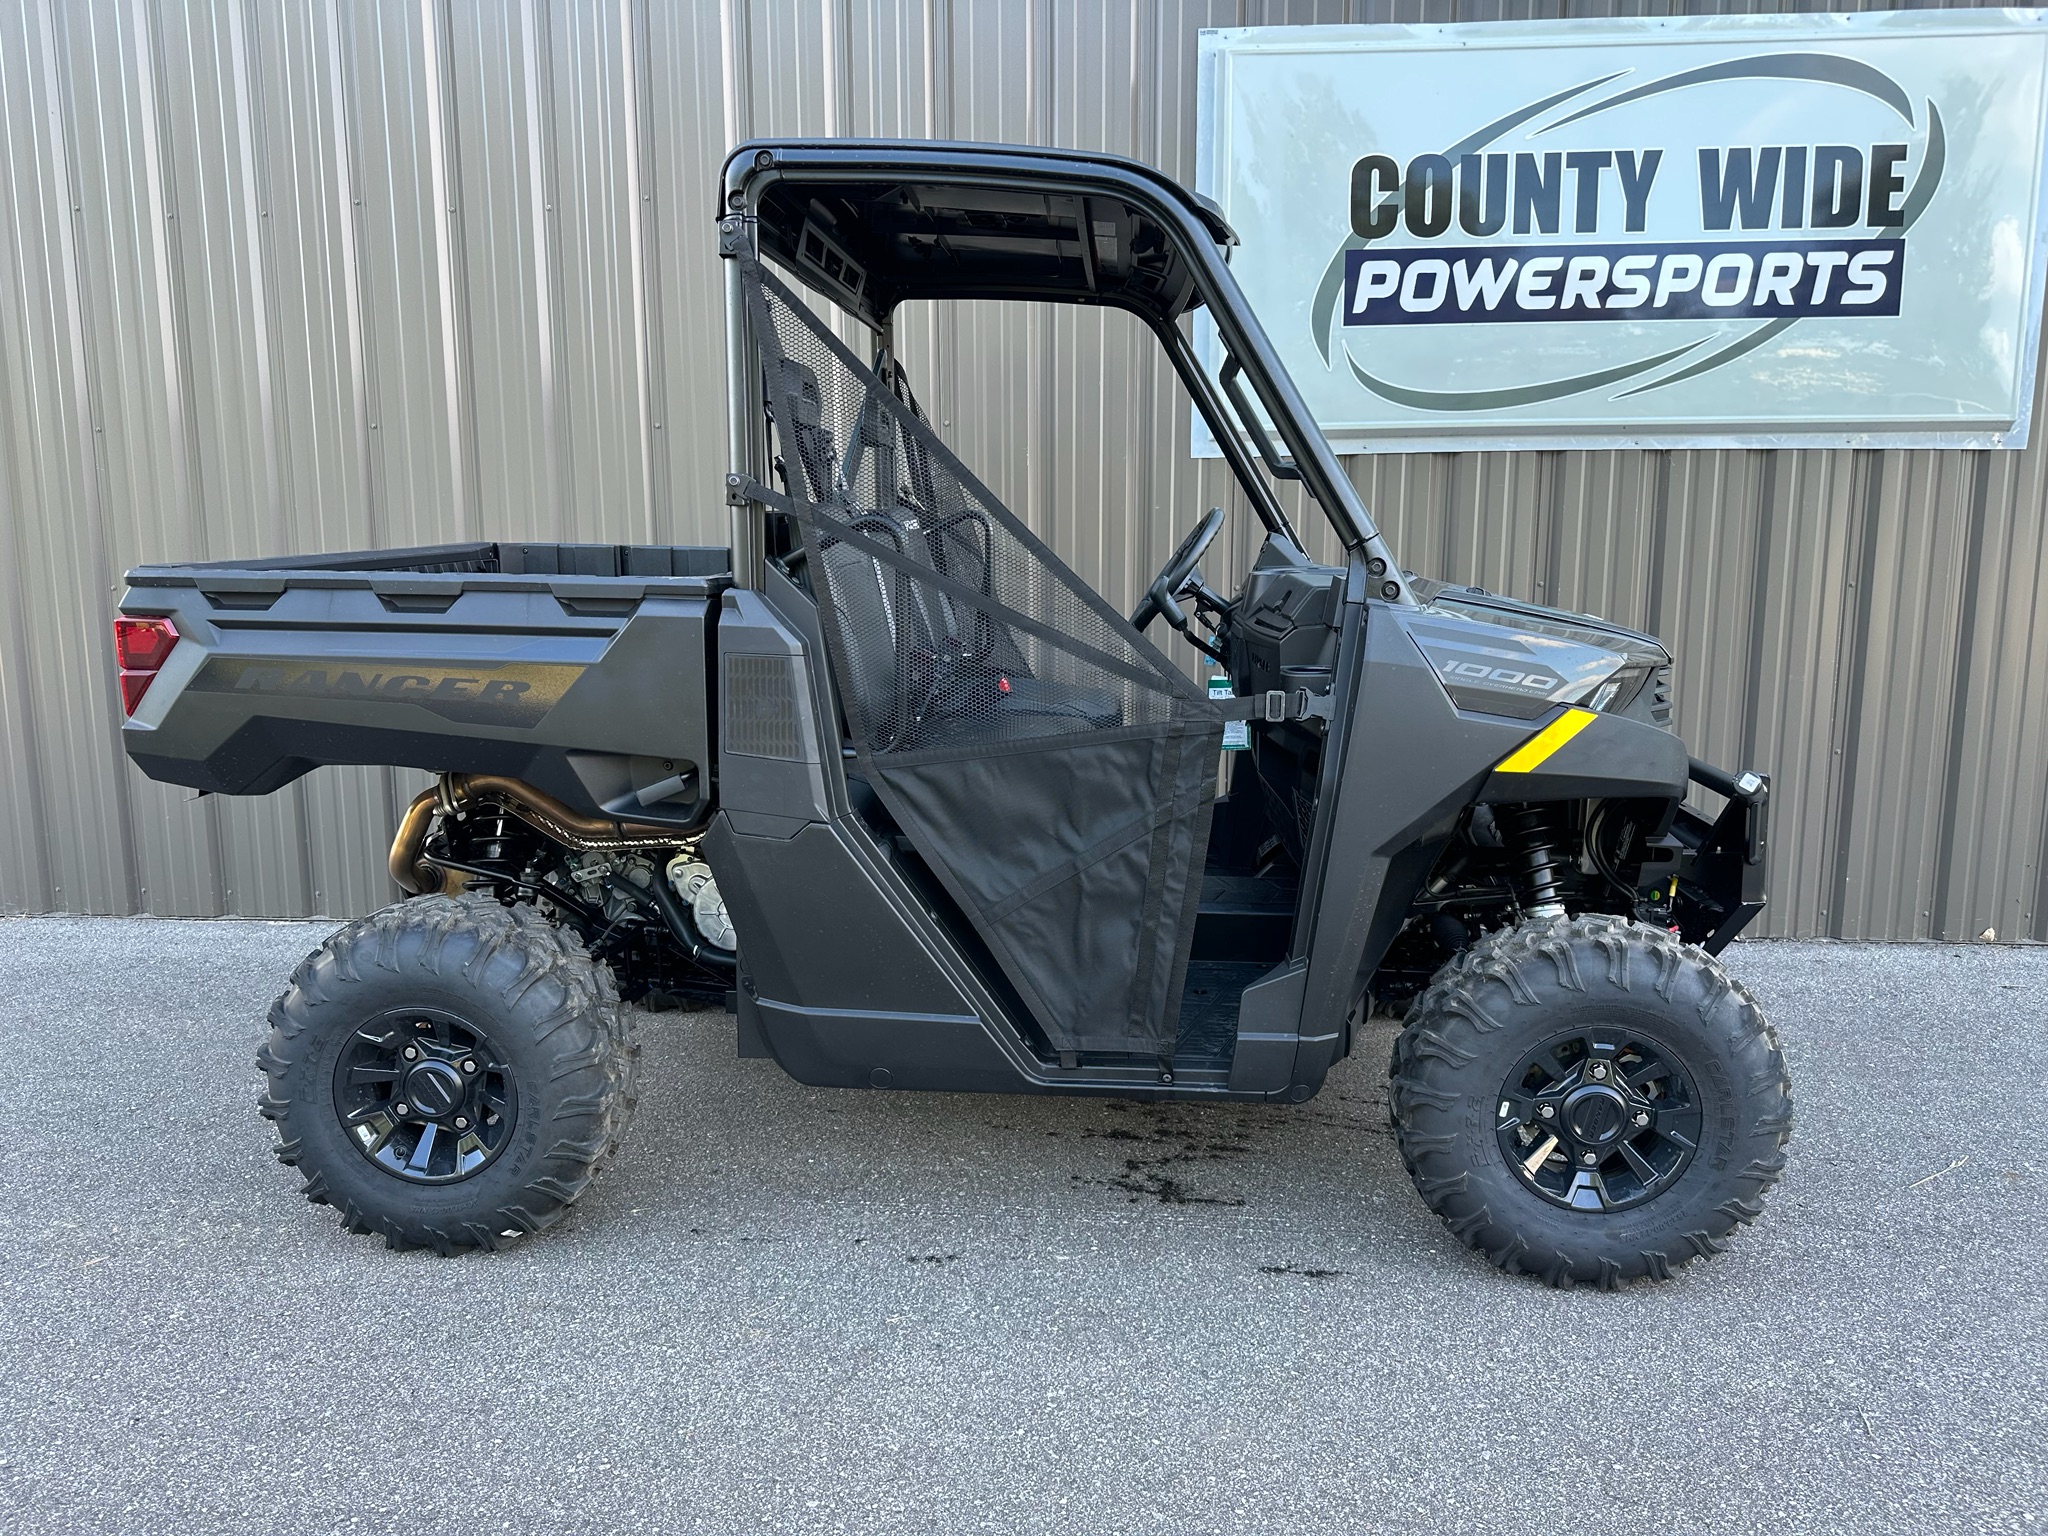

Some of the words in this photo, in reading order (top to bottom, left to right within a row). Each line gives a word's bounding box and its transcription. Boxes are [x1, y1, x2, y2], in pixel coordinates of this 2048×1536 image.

[1350, 149, 1664, 240] COUNTY
[1698, 144, 1908, 230] WIDE
[1352, 250, 1895, 314] POWERSPORTS
[234, 667, 532, 703] RANGER
[1442, 660, 1558, 690] 1000
[1449, 675, 1478, 684] SINGLE
[1482, 681, 1527, 693] OVERHEAD
[1528, 688, 1548, 696] CAM
[507, 1081, 540, 1177] CARLSTAR
[1704, 1060, 1735, 1171] CARLSTAR
